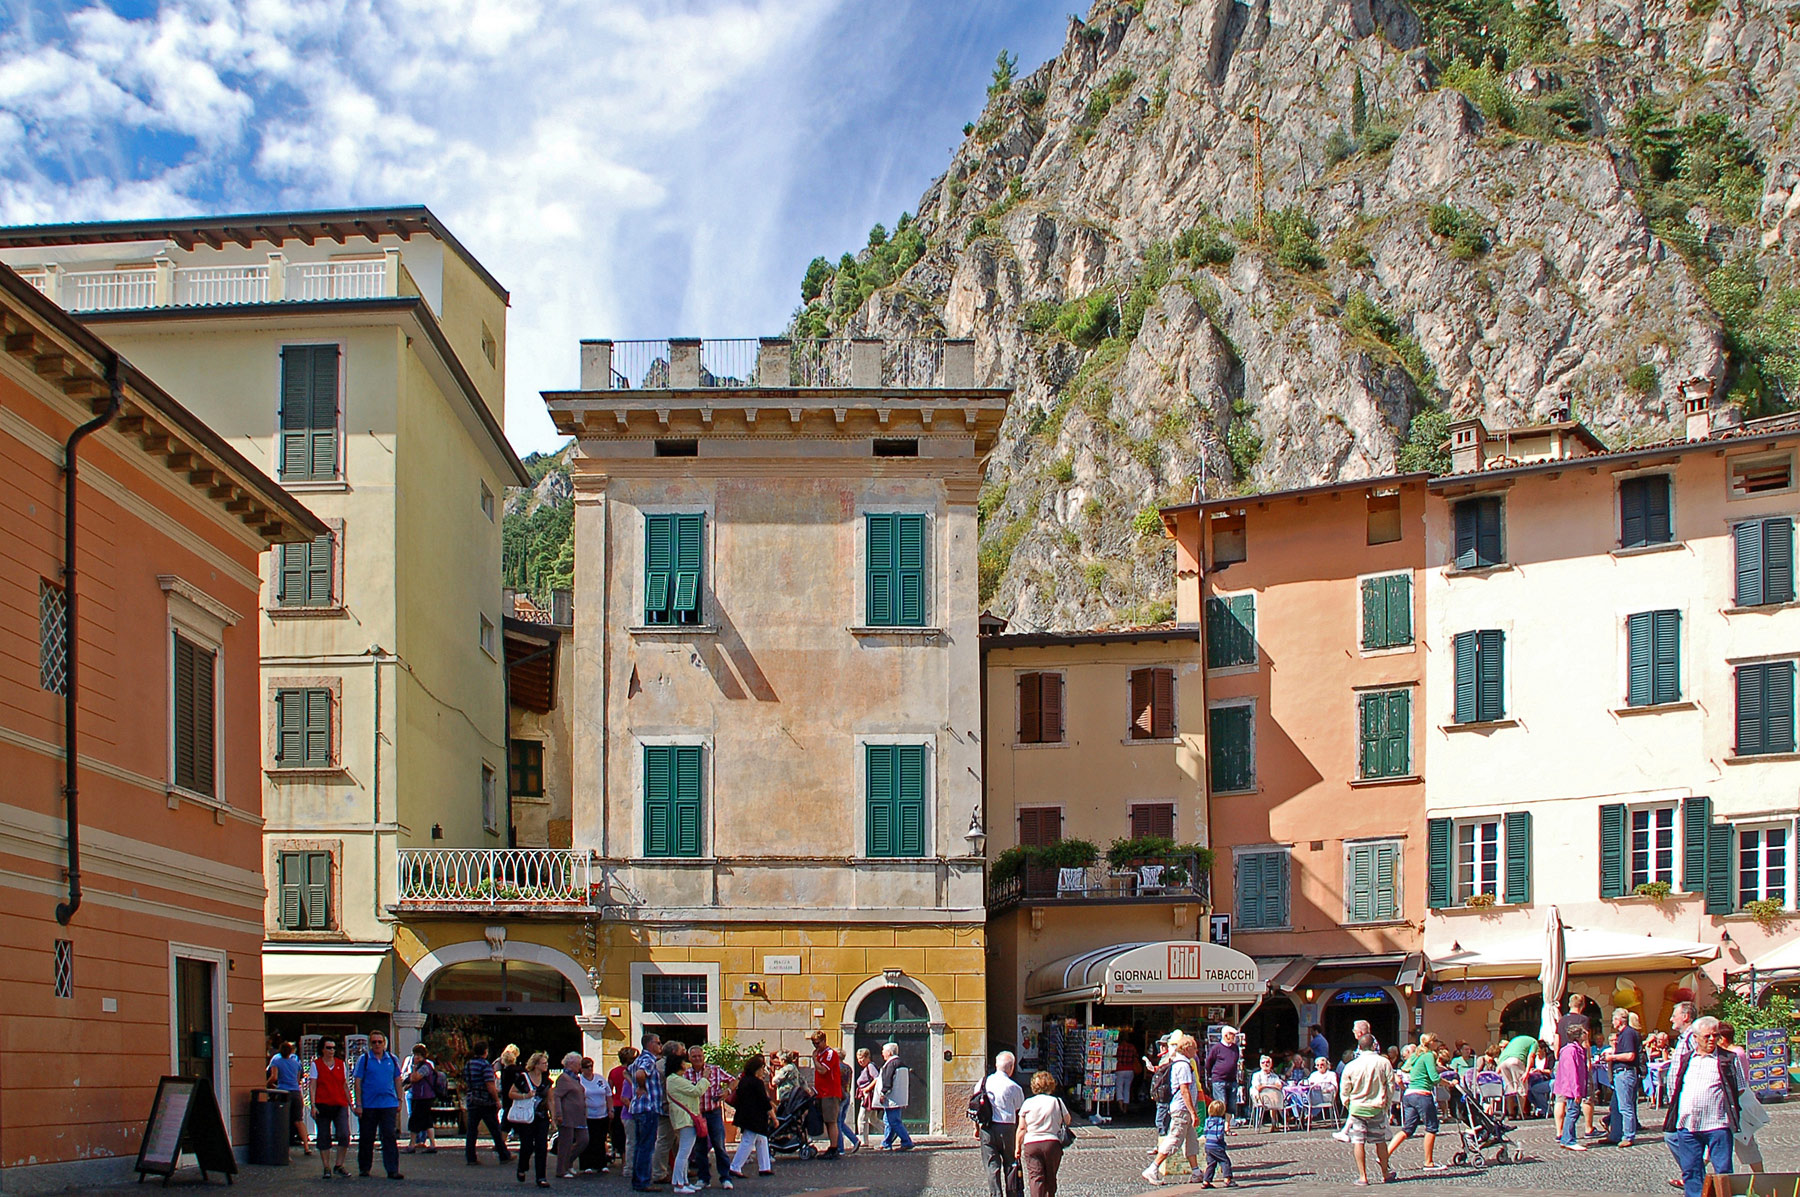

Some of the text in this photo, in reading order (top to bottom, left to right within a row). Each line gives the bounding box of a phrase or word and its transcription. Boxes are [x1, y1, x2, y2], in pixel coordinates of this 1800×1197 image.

[1211, 917, 1228, 940] T
[1170, 947, 1199, 978] Bild
[1114, 969, 1254, 981] GIORNALI TABACCHI
[1221, 982, 1255, 992] LOTTO
